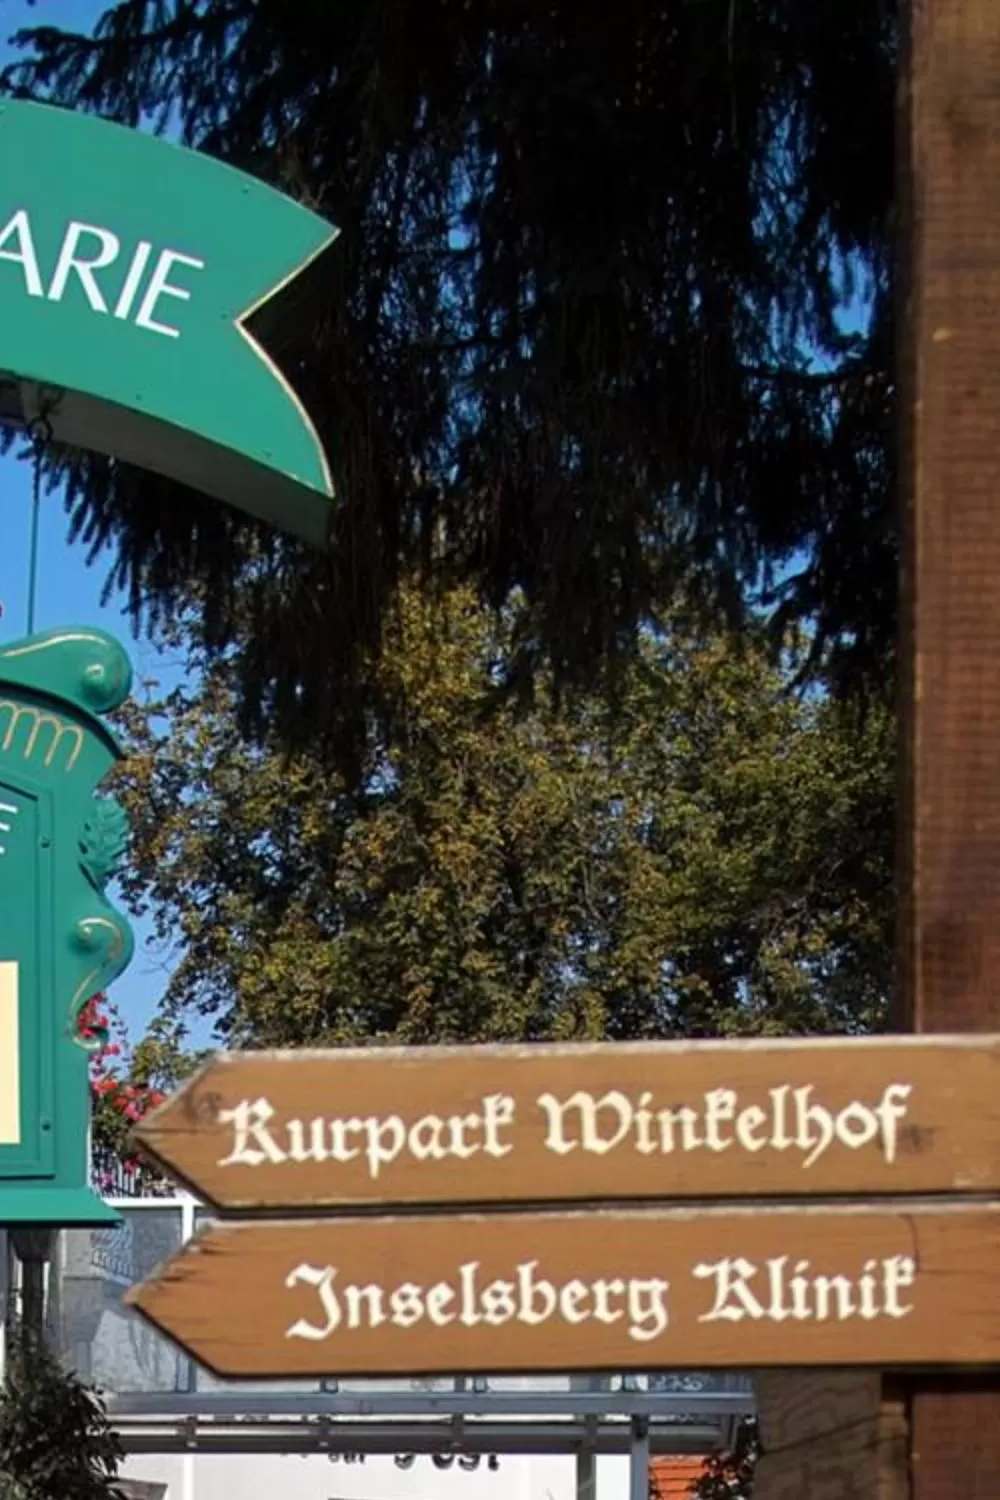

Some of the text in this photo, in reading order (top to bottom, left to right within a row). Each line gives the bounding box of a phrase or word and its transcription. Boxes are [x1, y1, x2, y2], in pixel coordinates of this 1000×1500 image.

[217, 1081, 914, 1178] Kurpark Winkelhof
[284, 1255, 917, 1341] Inselsberg Klinik
